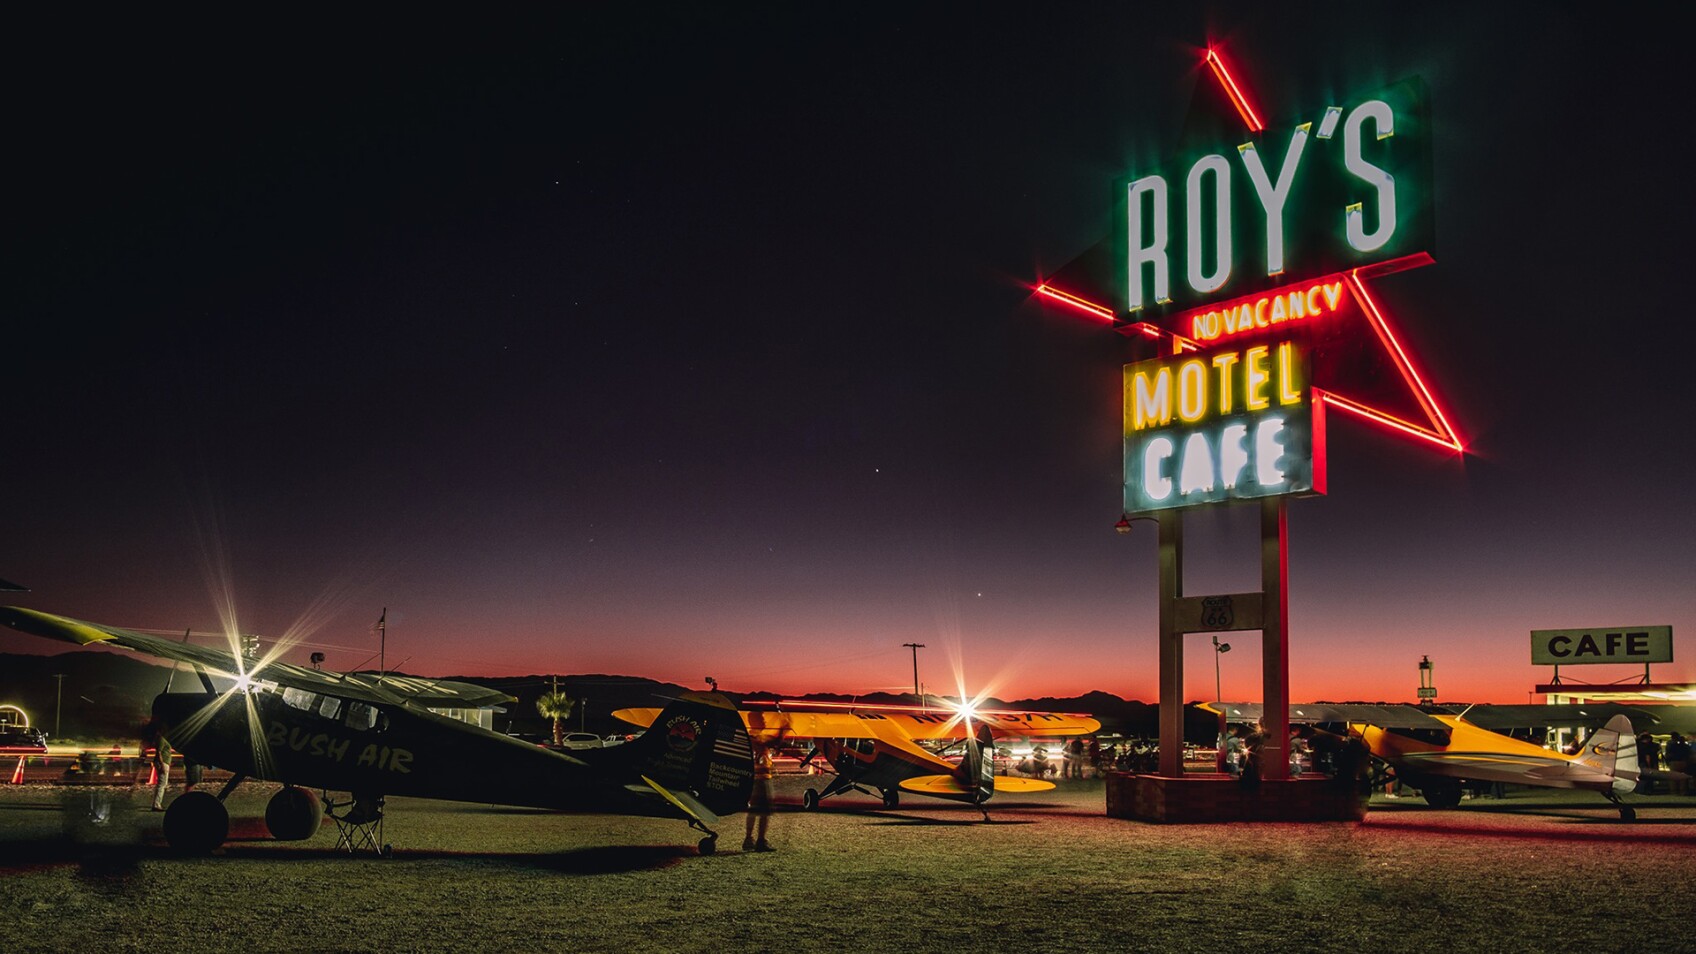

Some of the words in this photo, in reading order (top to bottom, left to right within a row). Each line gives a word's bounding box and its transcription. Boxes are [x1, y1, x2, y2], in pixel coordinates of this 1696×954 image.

[1128, 100, 1396, 312] ROY'S
[1193, 313, 1219, 340] NO
[1222, 281, 1342, 333] VACANCY
[1134, 341, 1301, 431] MOTEL
[1144, 418, 1285, 500] CAFE
[1207, 612, 1227, 626] 66
[1548, 632, 1649, 657] CAFE
[666, 715, 690, 729] BUSH
[689, 720, 702, 735] AIR
[269, 721, 350, 762] BUSH
[357, 744, 414, 774] AIR
[708, 768, 741, 780] Mountain
[710, 761, 753, 777] Backcountry
[706, 781, 725, 791] STOL
[708, 775, 740, 787] Tailwheel
